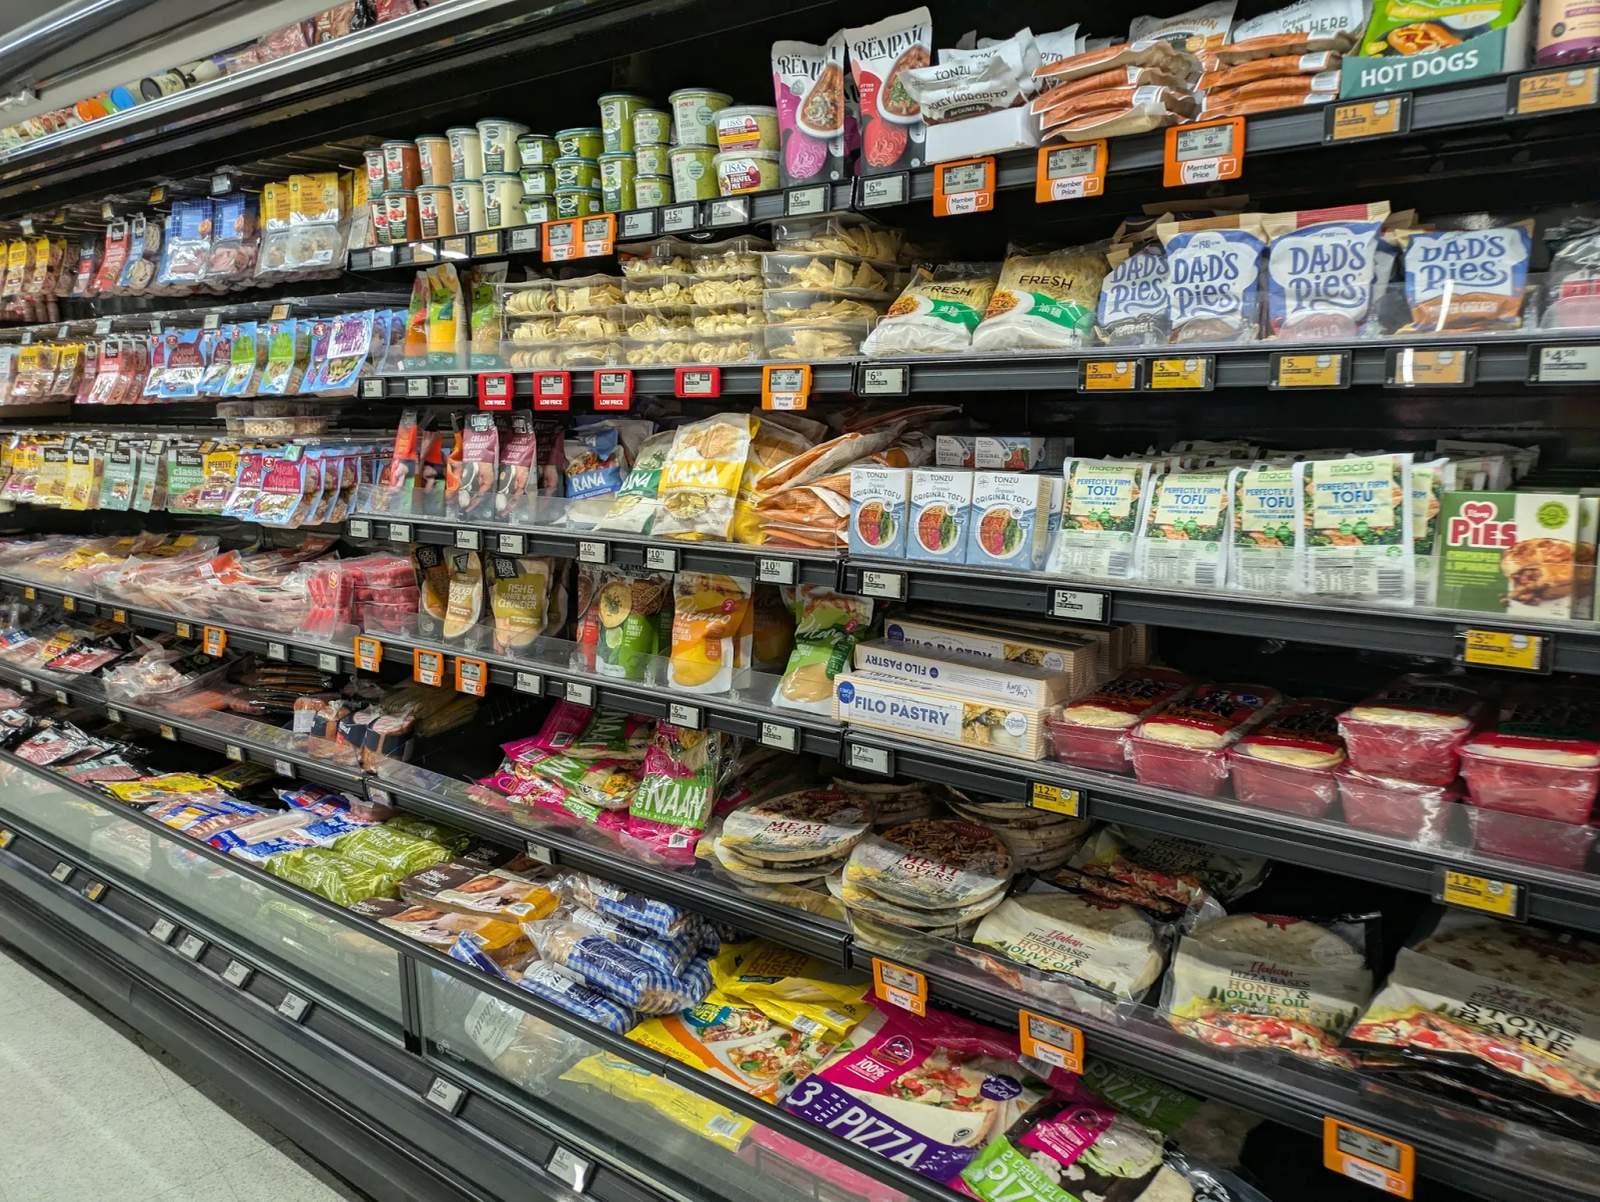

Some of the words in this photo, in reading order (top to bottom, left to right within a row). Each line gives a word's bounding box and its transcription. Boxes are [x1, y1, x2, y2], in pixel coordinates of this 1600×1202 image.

[1311, 17, 1349, 31] HERB
[1360, 63, 1407, 88] HOT
[1411, 49, 1479, 79] DOGS
[1186, 161, 1217, 174] Member
[1192, 169, 1210, 180] Price
[1056, 180, 1083, 191] Member
[1061, 187, 1077, 196] Price
[951, 195, 975, 205] Member
[955, 203, 970, 211] Price
[1289, 240, 1366, 276] DAD'S
[1419, 236, 1506, 263] DAD'S
[1172, 250, 1239, 284] DAD'S
[1419, 260, 1501, 291] Pies
[921, 285, 973, 297] FRESH
[1019, 275, 1074, 290] FRESH
[1289, 272, 1360, 312] Pies
[1173, 283, 1235, 320] Pies
[668, 462, 718, 484] RANA
[1330, 461, 1374, 473] macro
[572, 473, 605, 492] RANA
[1076, 478, 1113, 486] PERFECTLY
[1087, 486, 1117, 496] TOFU
[1316, 482, 1365, 491] PERFECTLY
[1367, 480, 1390, 489] FIRM
[853, 488, 883, 499] ORIGINAL
[914, 491, 947, 502] ORIGINAL
[947, 492, 967, 504] TOFU
[975, 494, 1010, 504] ORIGINAL
[1012, 495, 1033, 507] TOFU
[1174, 494, 1206, 505] TOFU
[1245, 488, 1287, 496] PERFECTLY
[1331, 490, 1374, 503] TOFU
[1259, 497, 1295, 508] TOFU
[497, 599, 537, 610] CHOWDER
[865, 654, 903, 671] PASTRY
[904, 663, 927, 676] FILO
[855, 695, 886, 714] FILO
[890, 702, 949, 726] PASTRY
[645, 778, 708, 820] NAAN
[764, 827, 822, 837] LOVERS
[767, 821, 825, 831] MEAT
[895, 859, 955, 882] LOVERS
[902, 853, 962, 876] MEAT
[1017, 939, 1072, 962] HONEY
[1069, 959, 1083, 968] &
[1026, 931, 1056, 948] PIZZA
[1056, 942, 1092, 959] BASES
[1010, 945, 1052, 964] OLIVE
[1053, 961, 1073, 972] OIL
[1230, 968, 1266, 982] PIZZA
[1269, 975, 1311, 988] BASES
[1226, 989, 1277, 1004] OLIVE
[1281, 998, 1310, 1009] OIL
[1228, 980, 1293, 998] HONEY
[1296, 990, 1311, 1000] &
[1460, 1001, 1576, 1047] STONE
[1457, 1011, 1569, 1058] BAKE
[855, 1058, 890, 1077] 100%
[786, 1081, 824, 1106] 3
[814, 1098, 849, 1122] CRISPY
[825, 1105, 929, 1171] PIZZA
